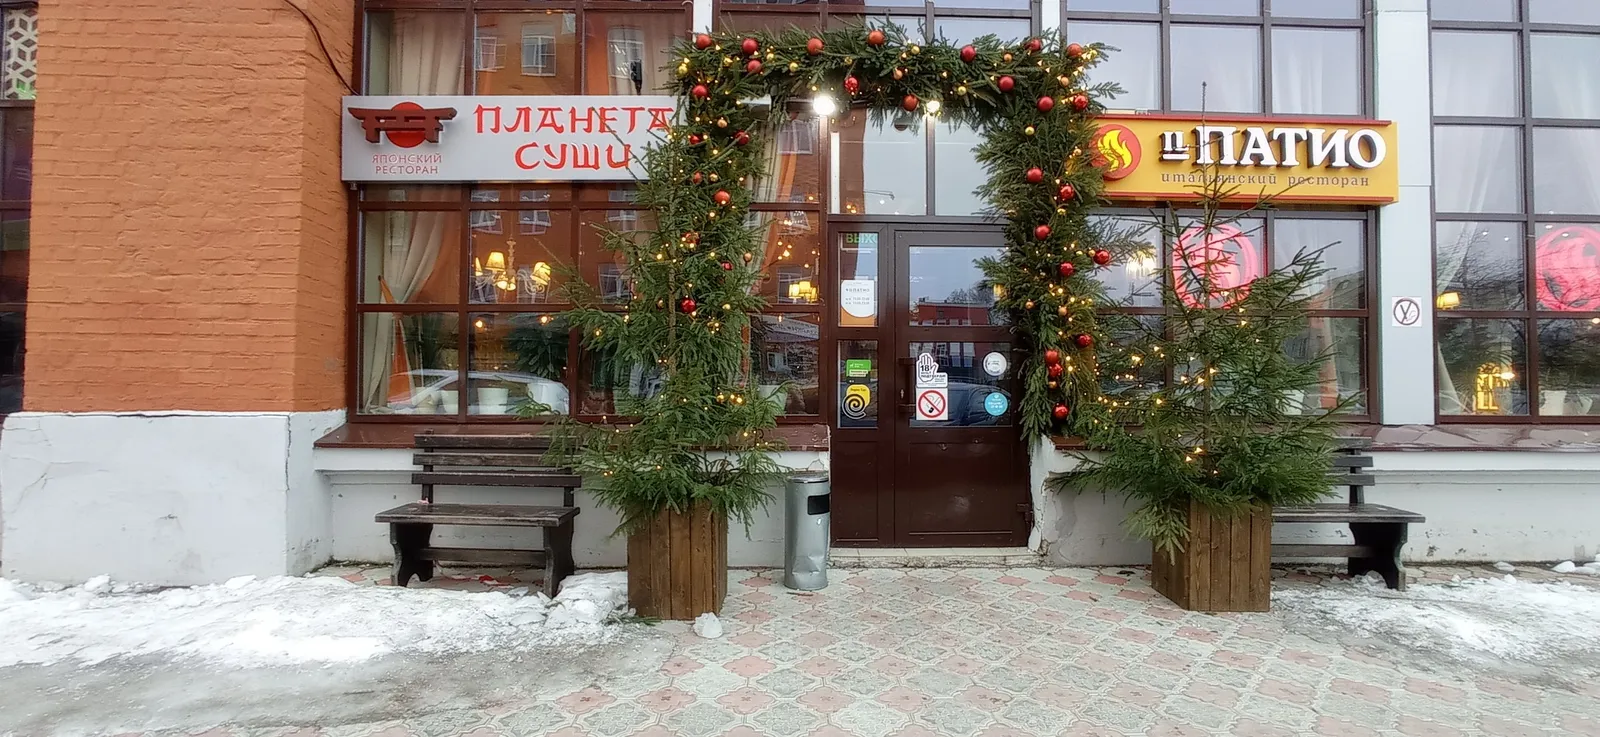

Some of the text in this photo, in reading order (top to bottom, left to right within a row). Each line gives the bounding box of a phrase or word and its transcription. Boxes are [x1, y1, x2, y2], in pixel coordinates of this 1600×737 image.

[473, 104, 674, 134] ПЛАНЕТА
[1194, 125, 1388, 168] ПАТИО
[372, 152, 442, 163] ЯПОНСКИЙ
[515, 142, 632, 170] СУШИ
[375, 165, 438, 174] РЕСТОРАН
[1288, 176, 1369, 188] ресторан
[920, 364, 930, 372] 18
